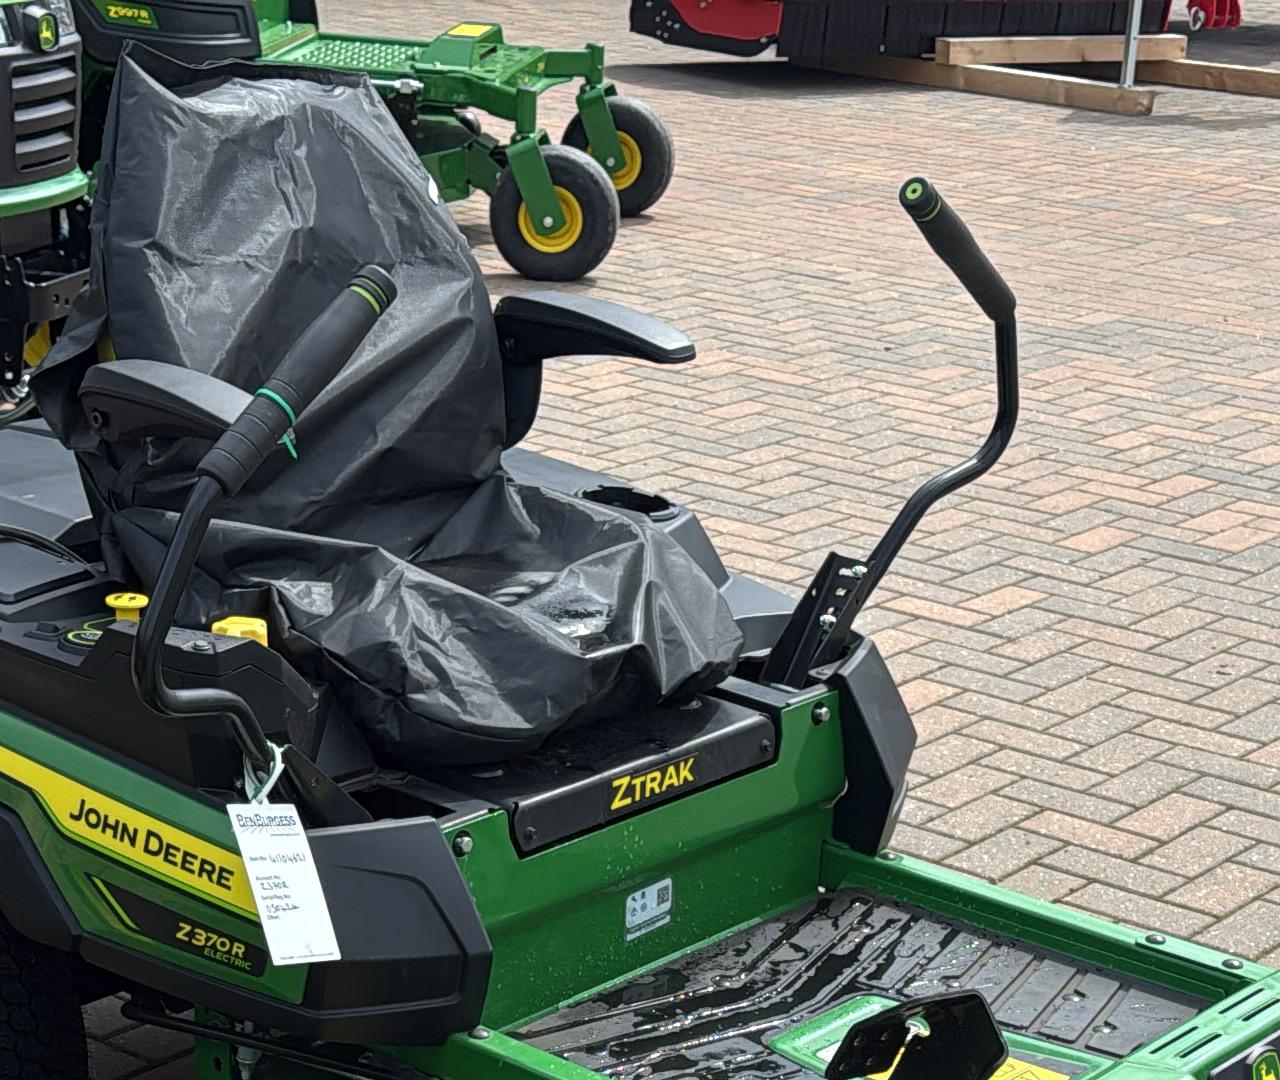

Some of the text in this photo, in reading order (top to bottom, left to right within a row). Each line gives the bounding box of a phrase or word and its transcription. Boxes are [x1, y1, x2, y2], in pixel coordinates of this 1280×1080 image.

[610, 757, 695, 811] ZTRAK
[69, 798, 235, 891] JOHN DEERE
[176, 922, 246, 958] Z370R
[204, 948, 253, 970] ELECTRIC
